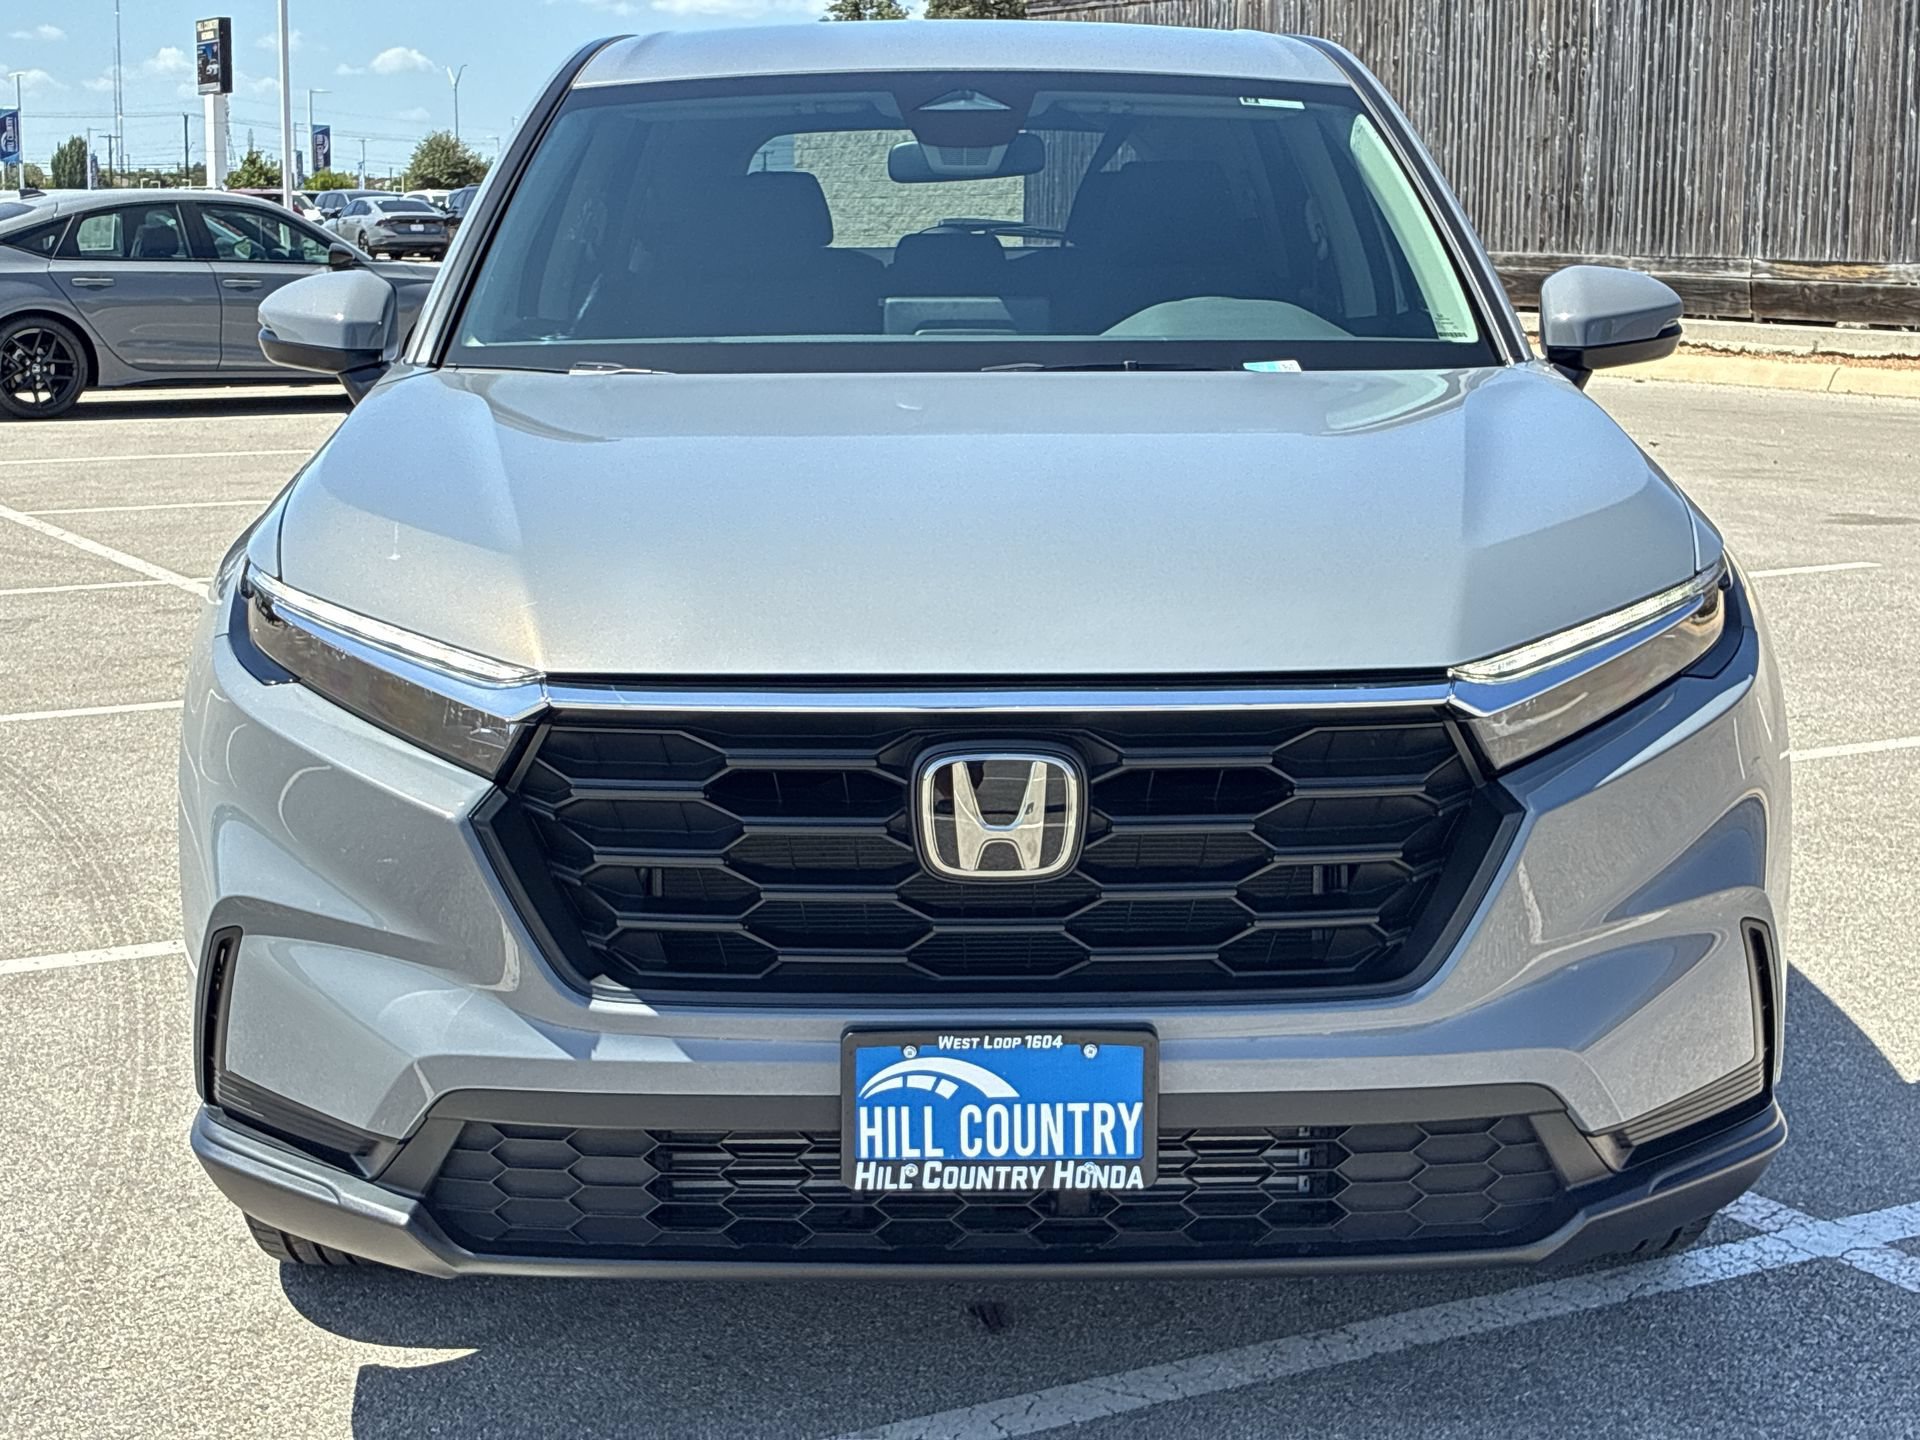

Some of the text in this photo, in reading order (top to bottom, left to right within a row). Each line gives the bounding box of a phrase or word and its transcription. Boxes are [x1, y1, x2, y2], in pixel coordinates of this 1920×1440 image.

[938, 1034, 1063, 1049] WEST LOOP 1604
[859, 1102, 1143, 1159] HILL COUNTRY
[922, 1160, 1045, 1190] COUNTRY
[1052, 1160, 1144, 1189] HONDA
